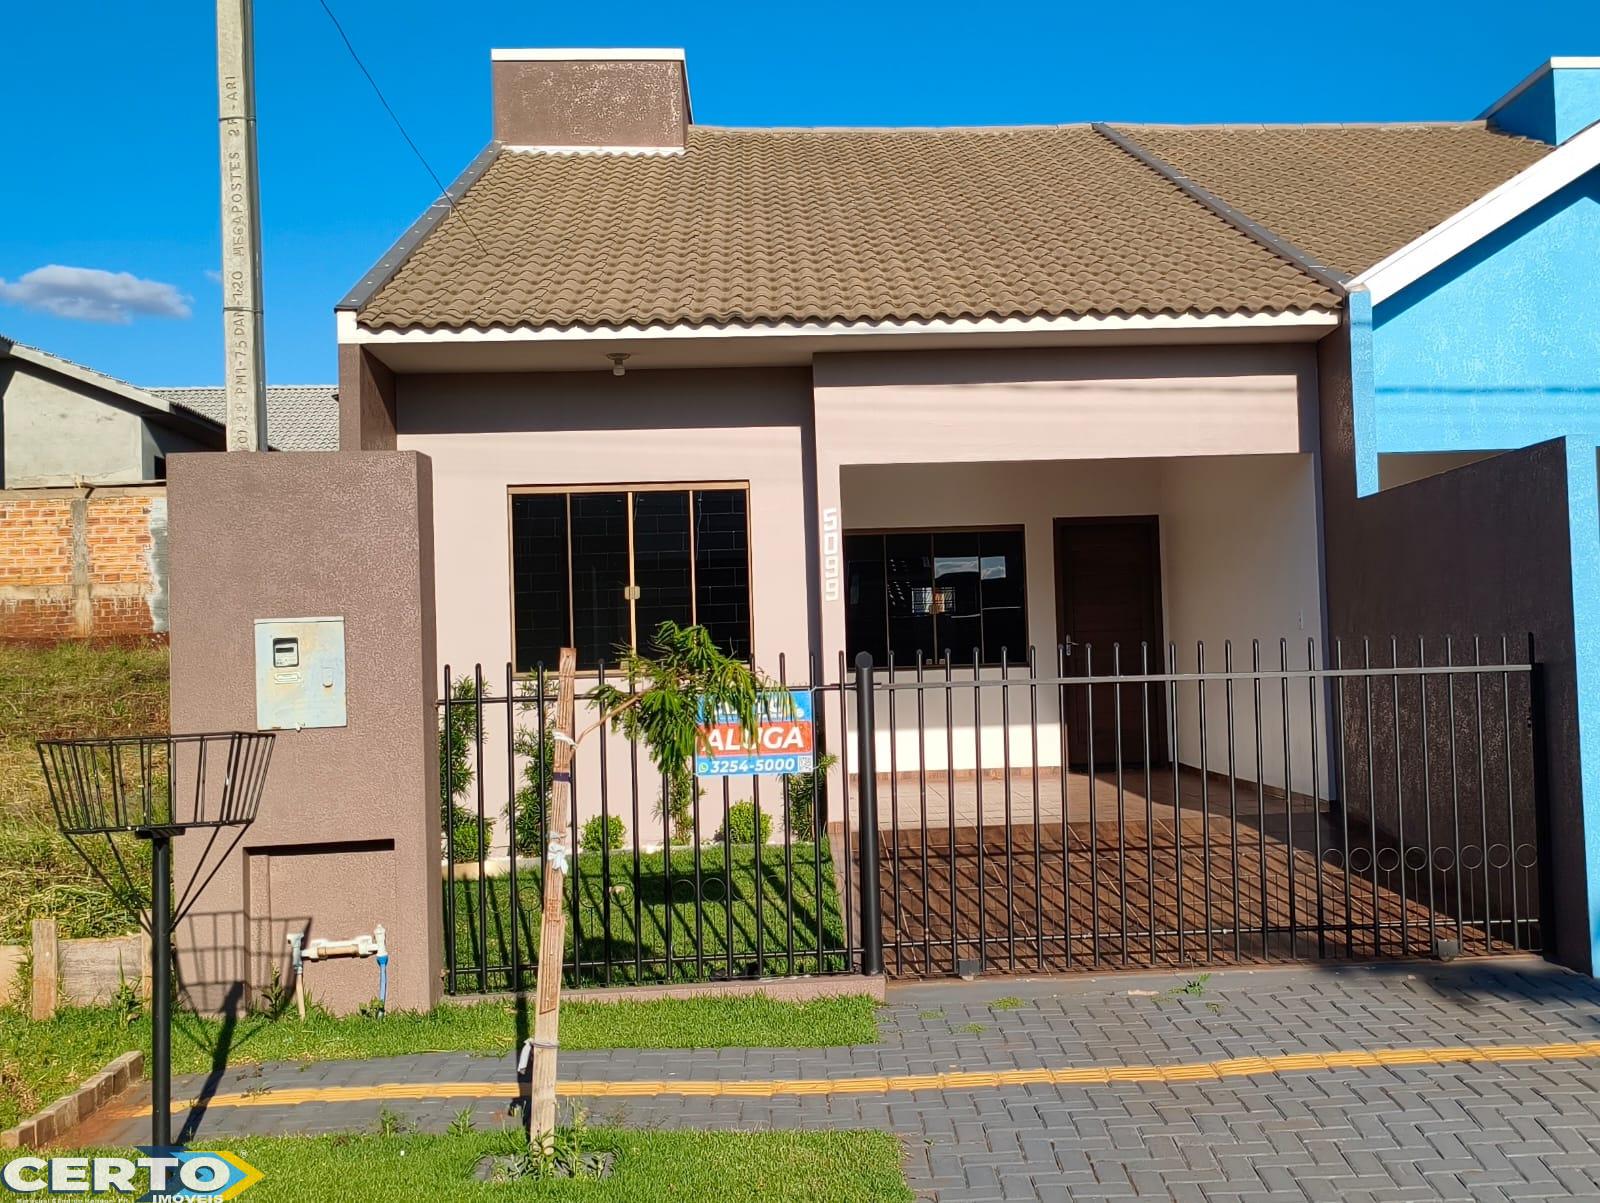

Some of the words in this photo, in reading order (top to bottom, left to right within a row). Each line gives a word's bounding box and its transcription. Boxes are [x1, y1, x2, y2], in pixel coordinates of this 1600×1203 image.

[229, 151, 245, 257] MEGAPOSTES
[823, 507, 839, 601] 5099
[702, 726, 804, 752] ALUGA
[710, 758, 795, 773] 3254-5000
